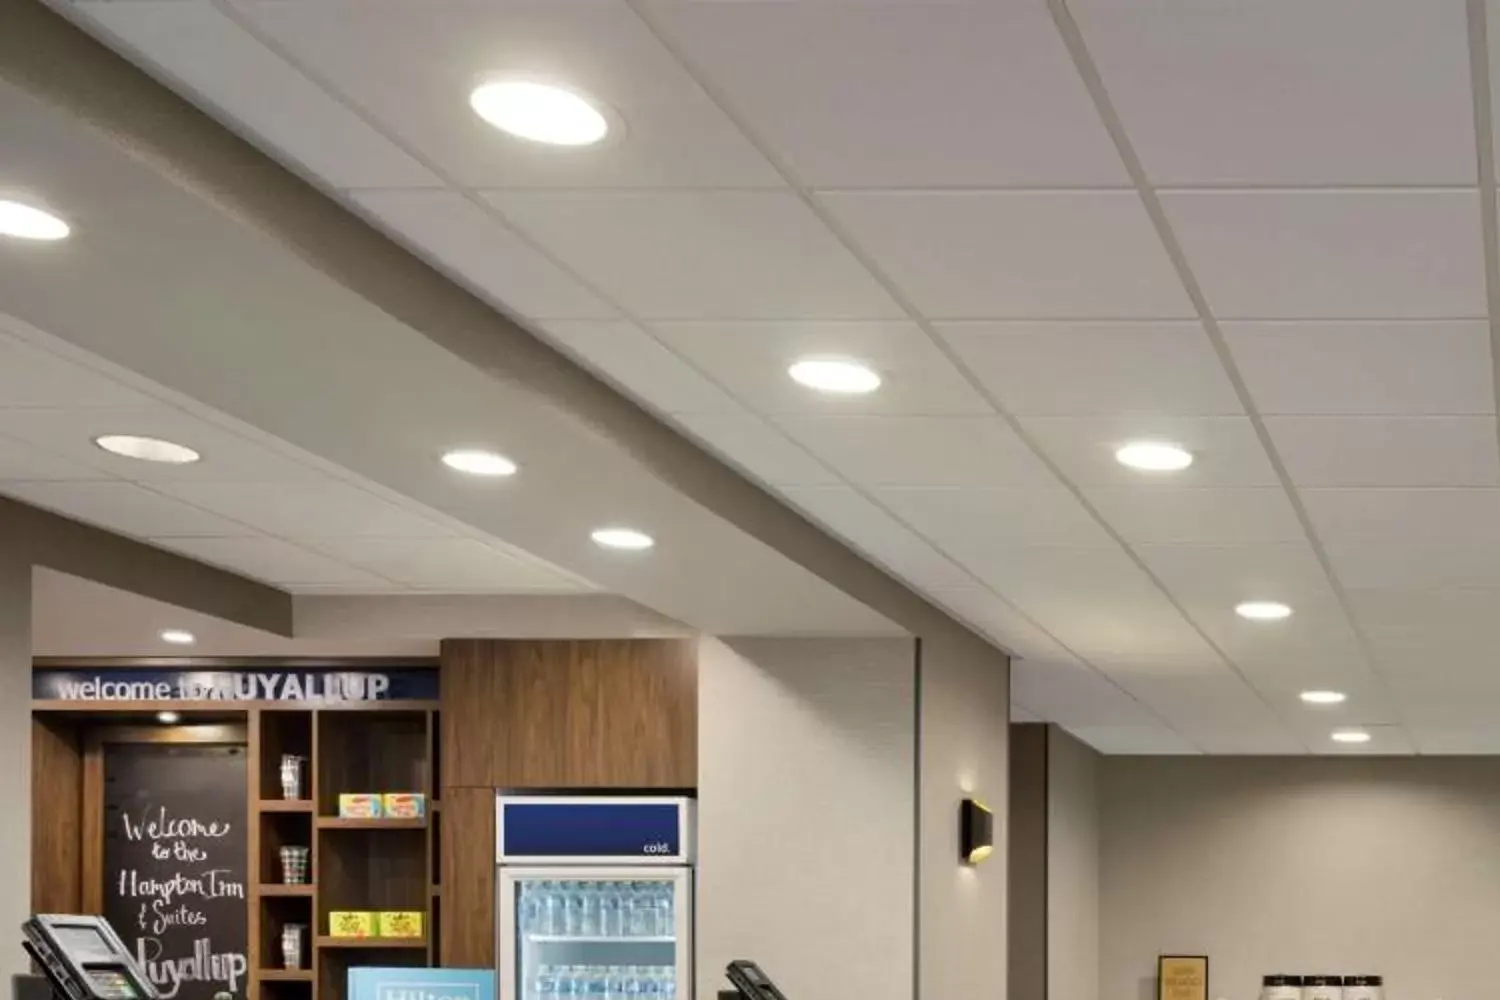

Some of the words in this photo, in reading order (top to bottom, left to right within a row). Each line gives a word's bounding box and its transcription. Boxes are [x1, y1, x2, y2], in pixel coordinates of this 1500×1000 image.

[57, 676, 171, 700] welcome
[123, 804, 231, 840] Welcome
[152, 841, 170, 860] to
[174, 840, 207, 862] the
[119, 869, 205, 905] Hampton
[202, 869, 244, 899] Inn
[152, 899, 207, 935] Suites
[136, 936, 247, 999] Puyallup
